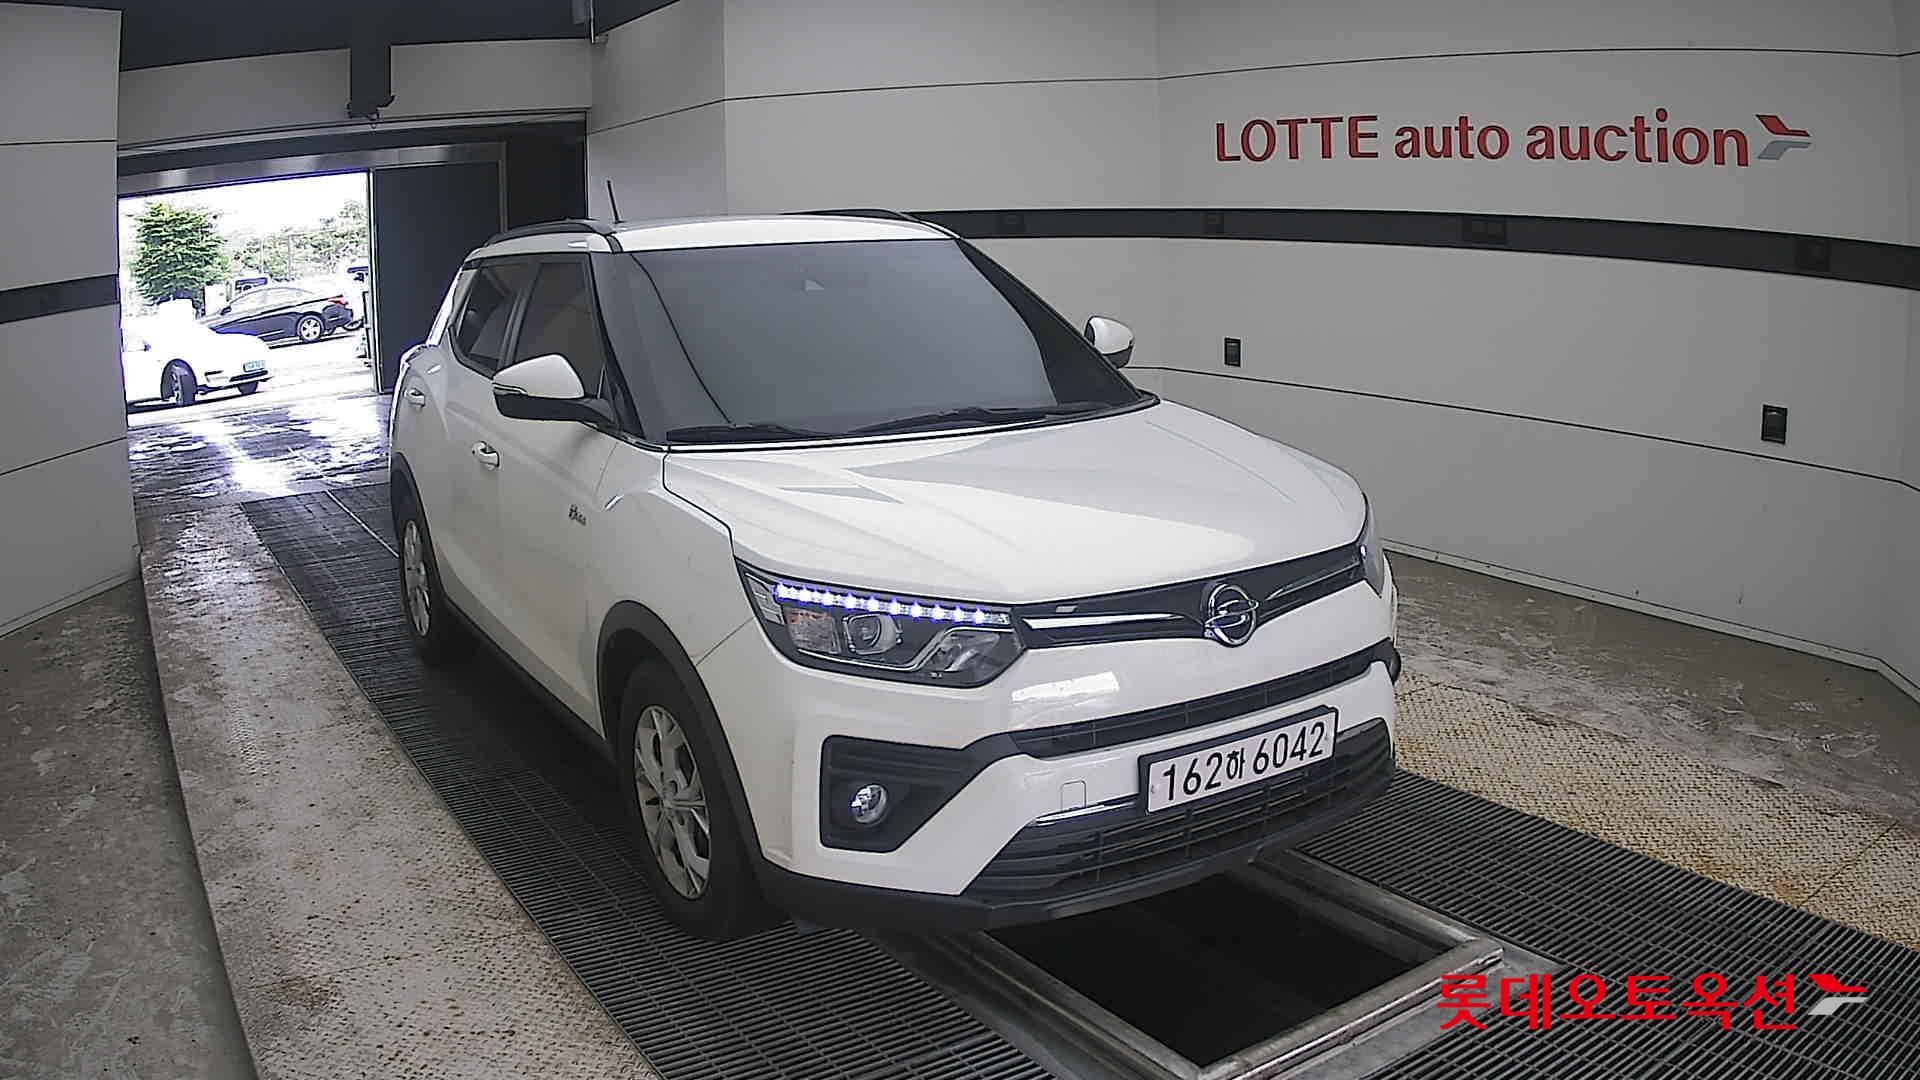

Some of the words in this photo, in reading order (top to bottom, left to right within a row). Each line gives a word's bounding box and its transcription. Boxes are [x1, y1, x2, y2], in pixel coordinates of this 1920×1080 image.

[1216, 115, 1379, 162] LOTTE
[1395, 116, 1510, 160] auto
[1526, 109, 1749, 166] auction
[1163, 748, 1245, 800] 162하
[1253, 722, 1325, 774] 6042
